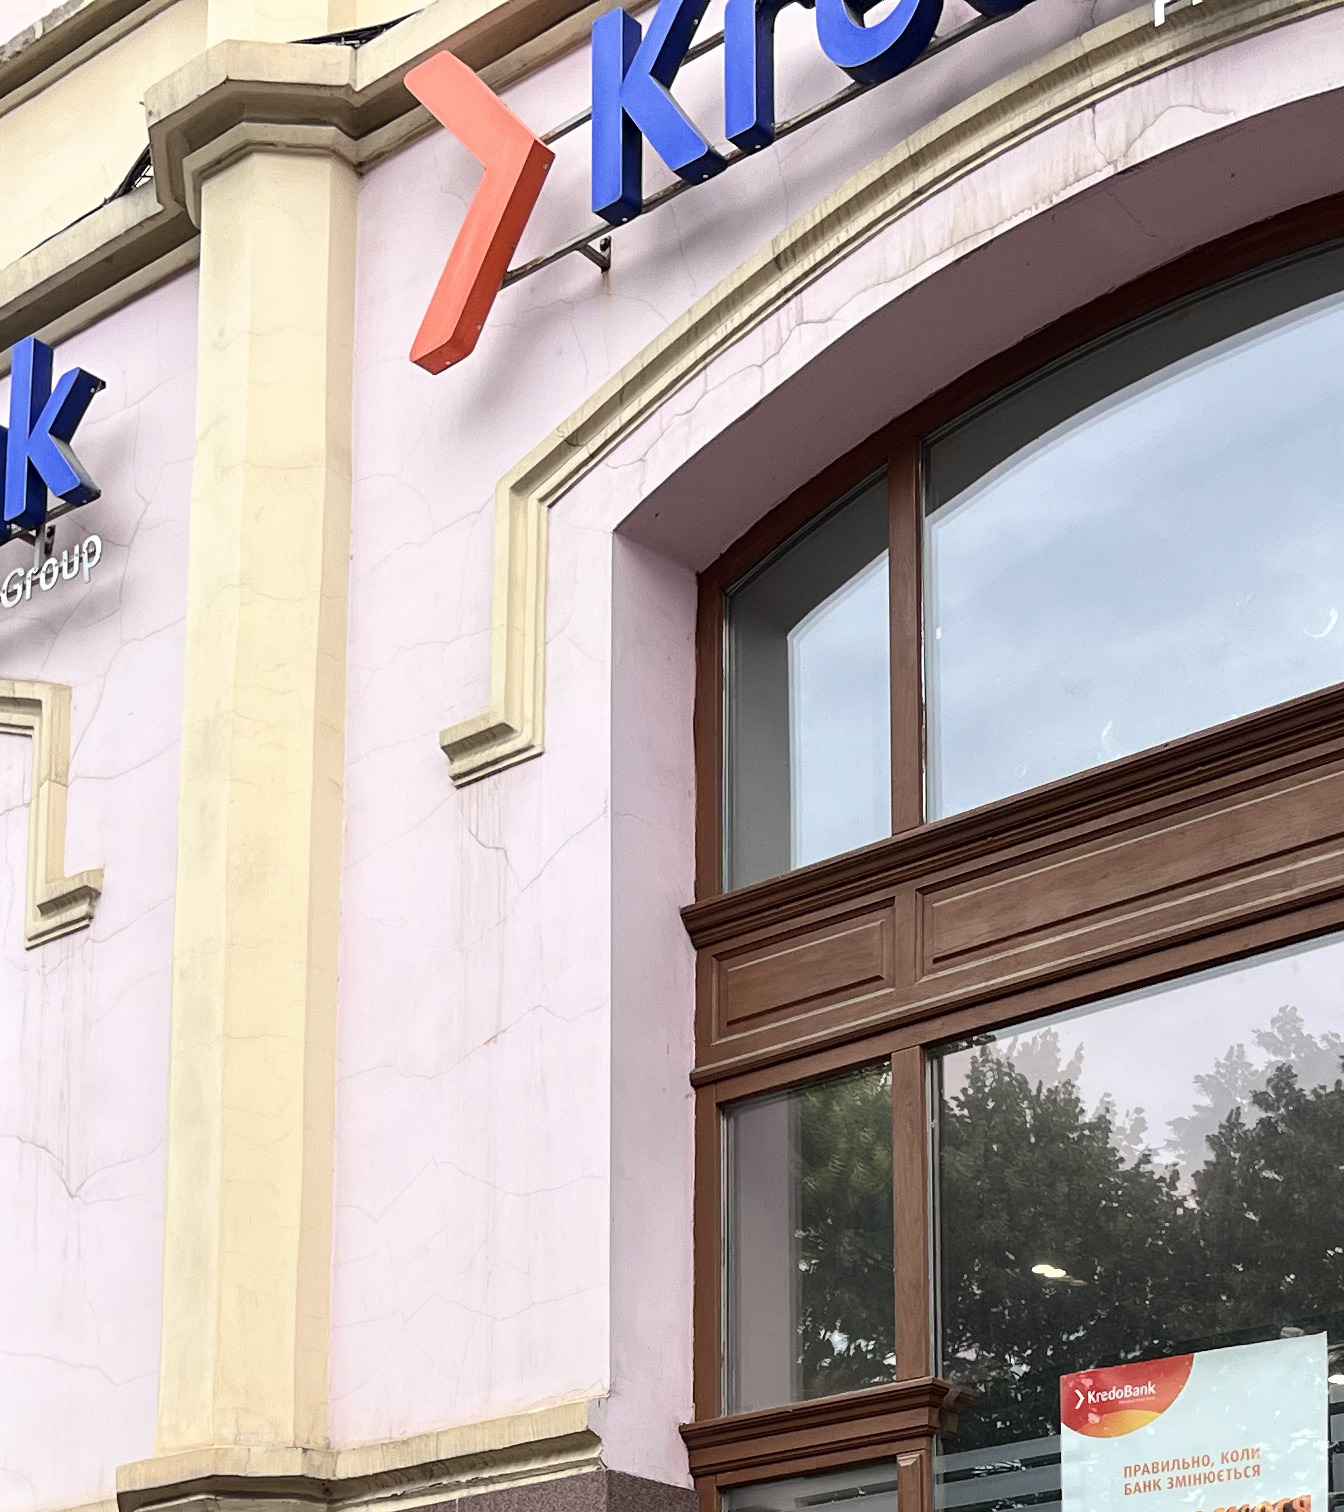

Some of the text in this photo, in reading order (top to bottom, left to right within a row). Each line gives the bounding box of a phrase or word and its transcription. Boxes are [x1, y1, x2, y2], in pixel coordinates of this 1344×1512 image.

[1, 535, 102, 608] Group
[1087, 1381, 1156, 1404] KredoBank
[1123, 1447, 1261, 1479] ПРАВИЛЬНО, КОЛИ
[1124, 1463, 1261, 1496] БАНК ЗМІНЮЄТЬСЯ
